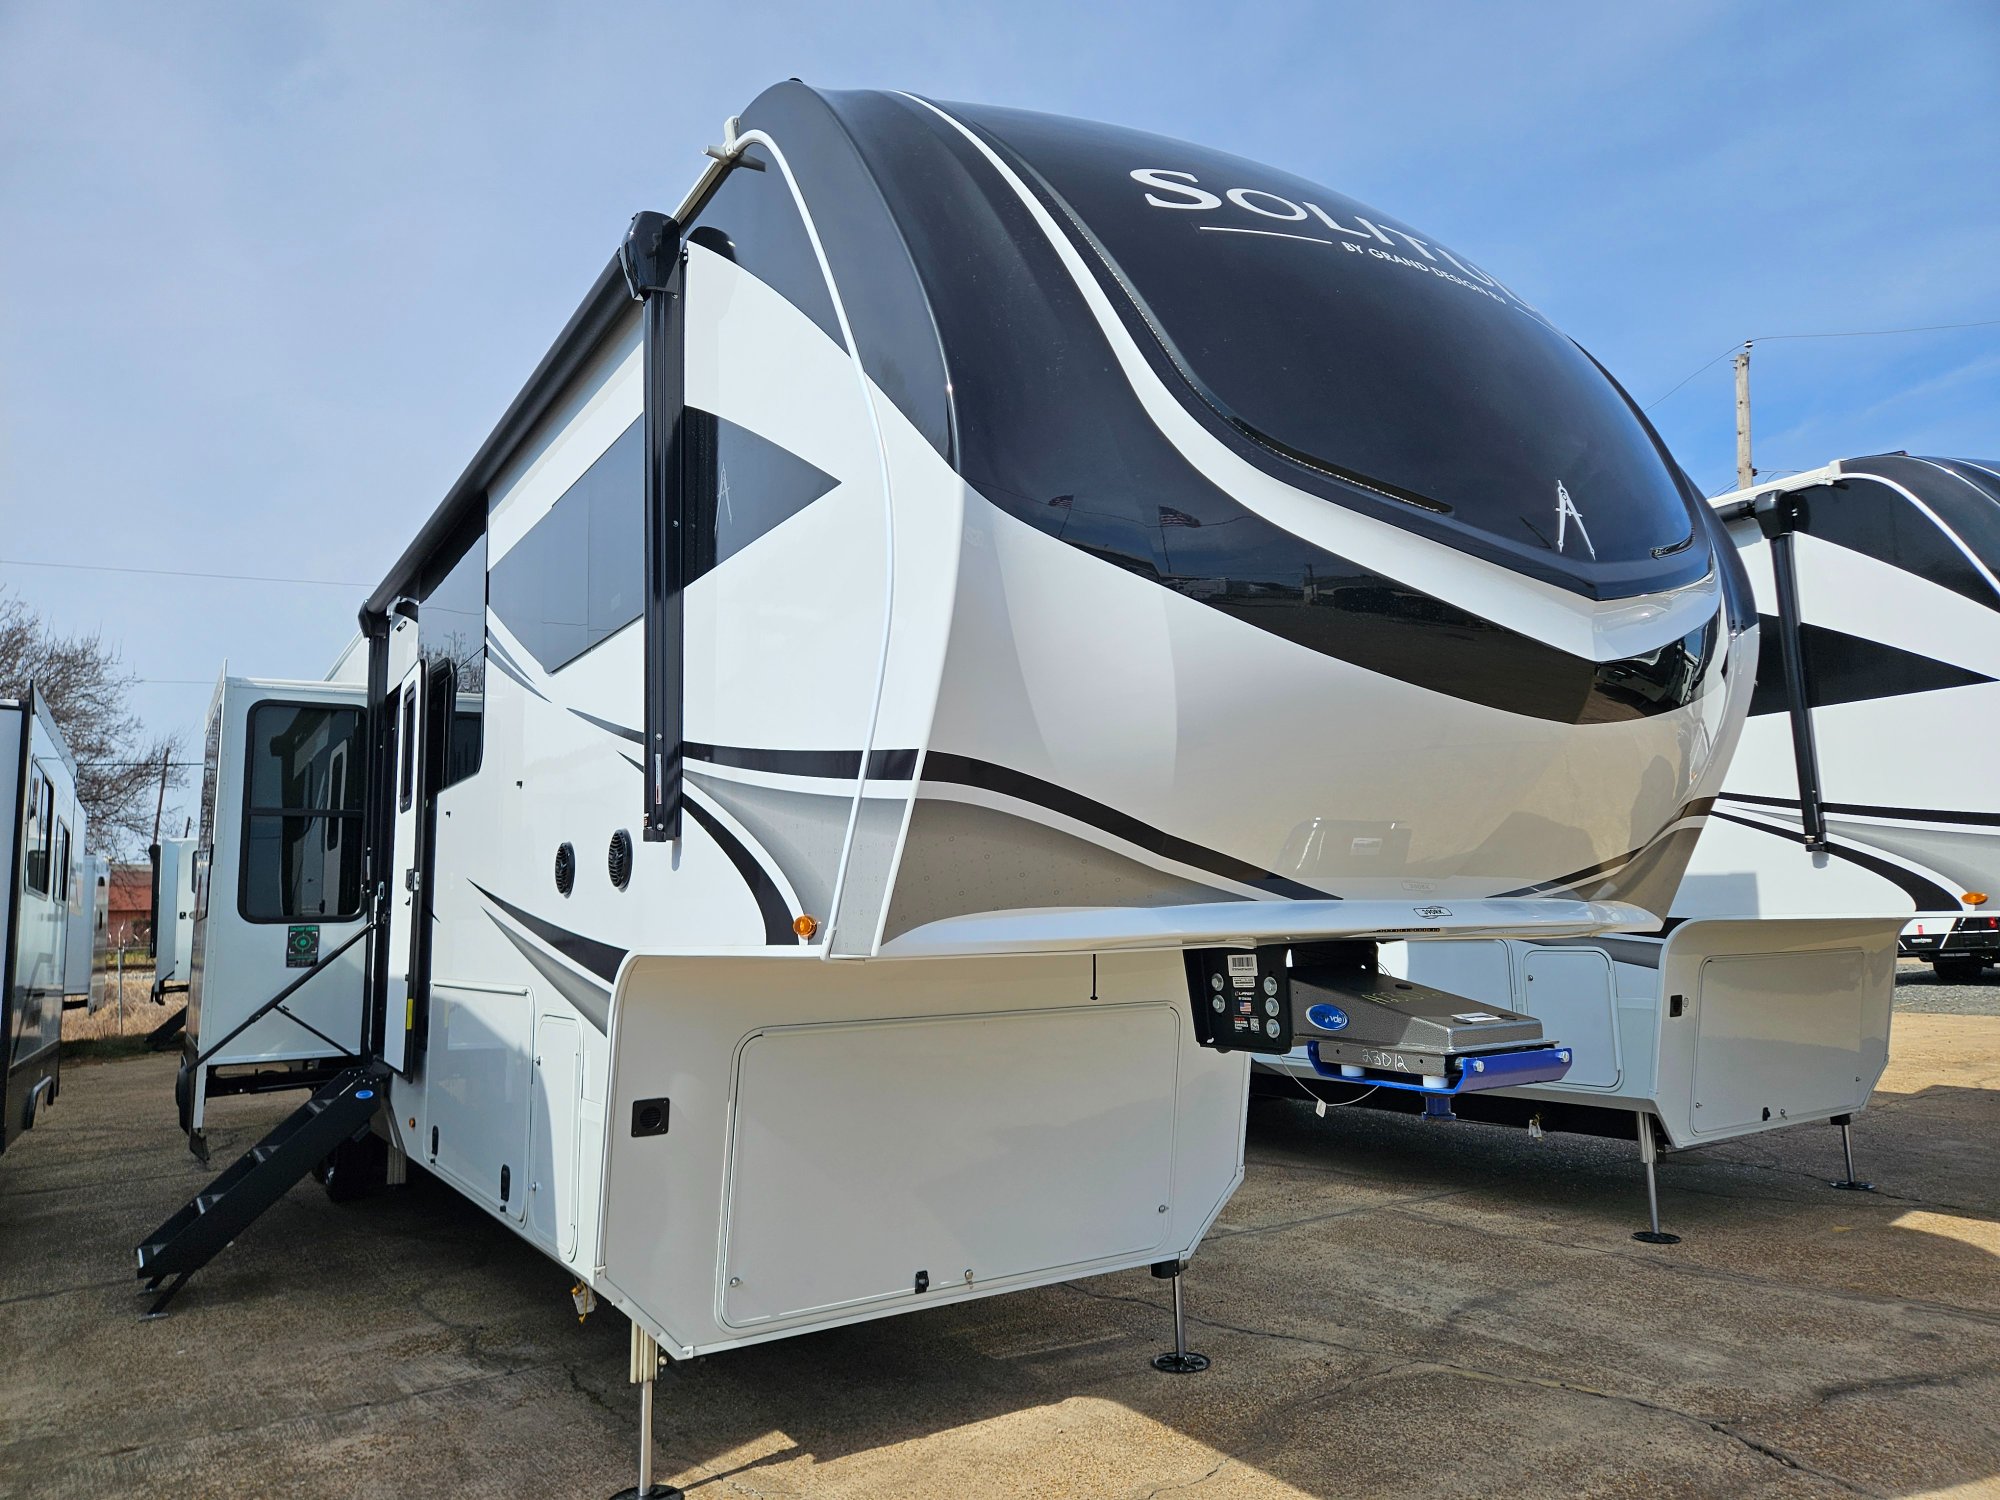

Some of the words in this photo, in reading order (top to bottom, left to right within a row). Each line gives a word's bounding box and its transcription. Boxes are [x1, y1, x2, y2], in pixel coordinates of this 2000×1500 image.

[1130, 168, 1537, 313] SOLITU
[1341, 241, 1364, 254] BY
[1368, 248, 1429, 272] GRAND
[1430, 267, 1489, 296] DESIGN
